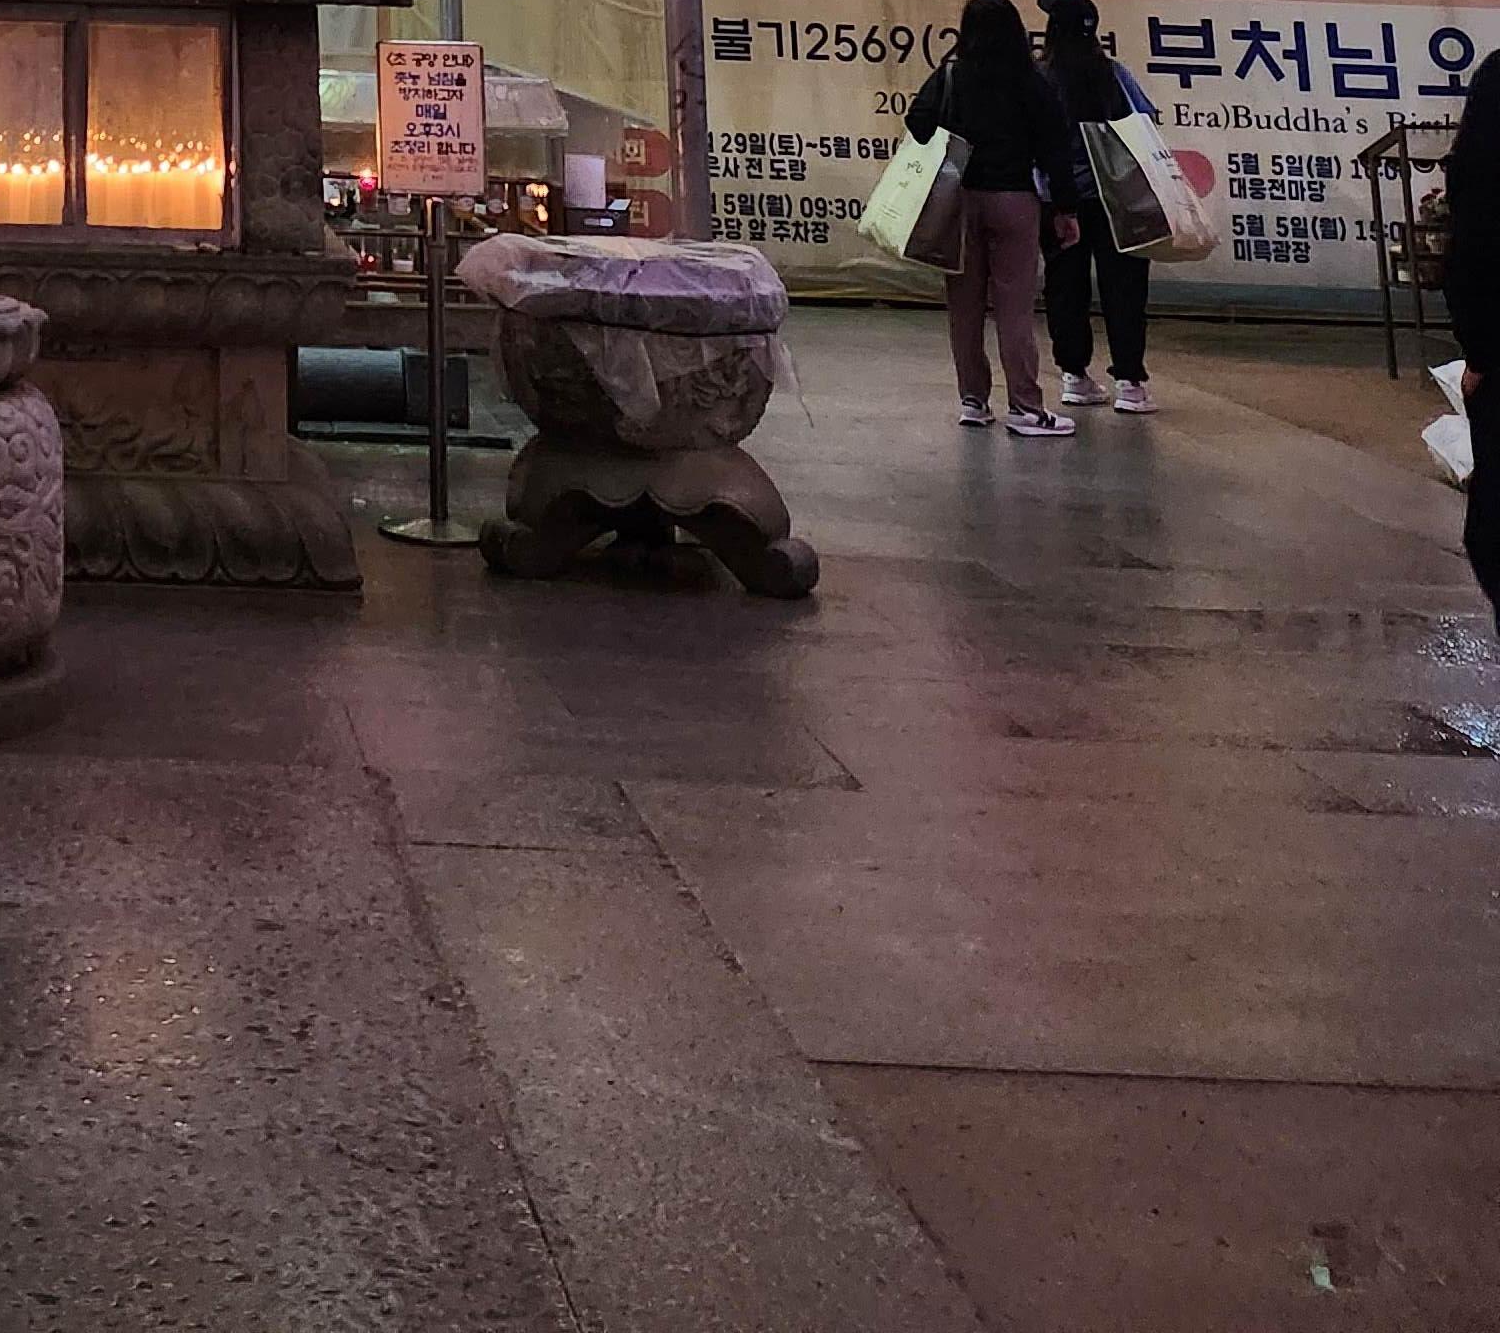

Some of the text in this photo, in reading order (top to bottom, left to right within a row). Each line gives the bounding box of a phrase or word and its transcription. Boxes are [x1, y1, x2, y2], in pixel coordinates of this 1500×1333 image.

[415, 103, 447, 120] 매일
[404, 122, 461, 139] 오후3시
[745, 158, 764, 180] 전
[769, 158, 808, 182] 도량
[1227, 152, 1261, 177] 5월
[1271, 154, 1342, 179] 5일(월)
[1228, 178, 1327, 204] 대웅전마당
[723, 192, 866, 221] 5일(월) 09:30
[772, 221, 830, 244] 주차장
[1231, 215, 1264, 239] 5월
[1276, 215, 1347, 241] 5일(월)
[1233, 238, 1312, 264] 미륵광장
